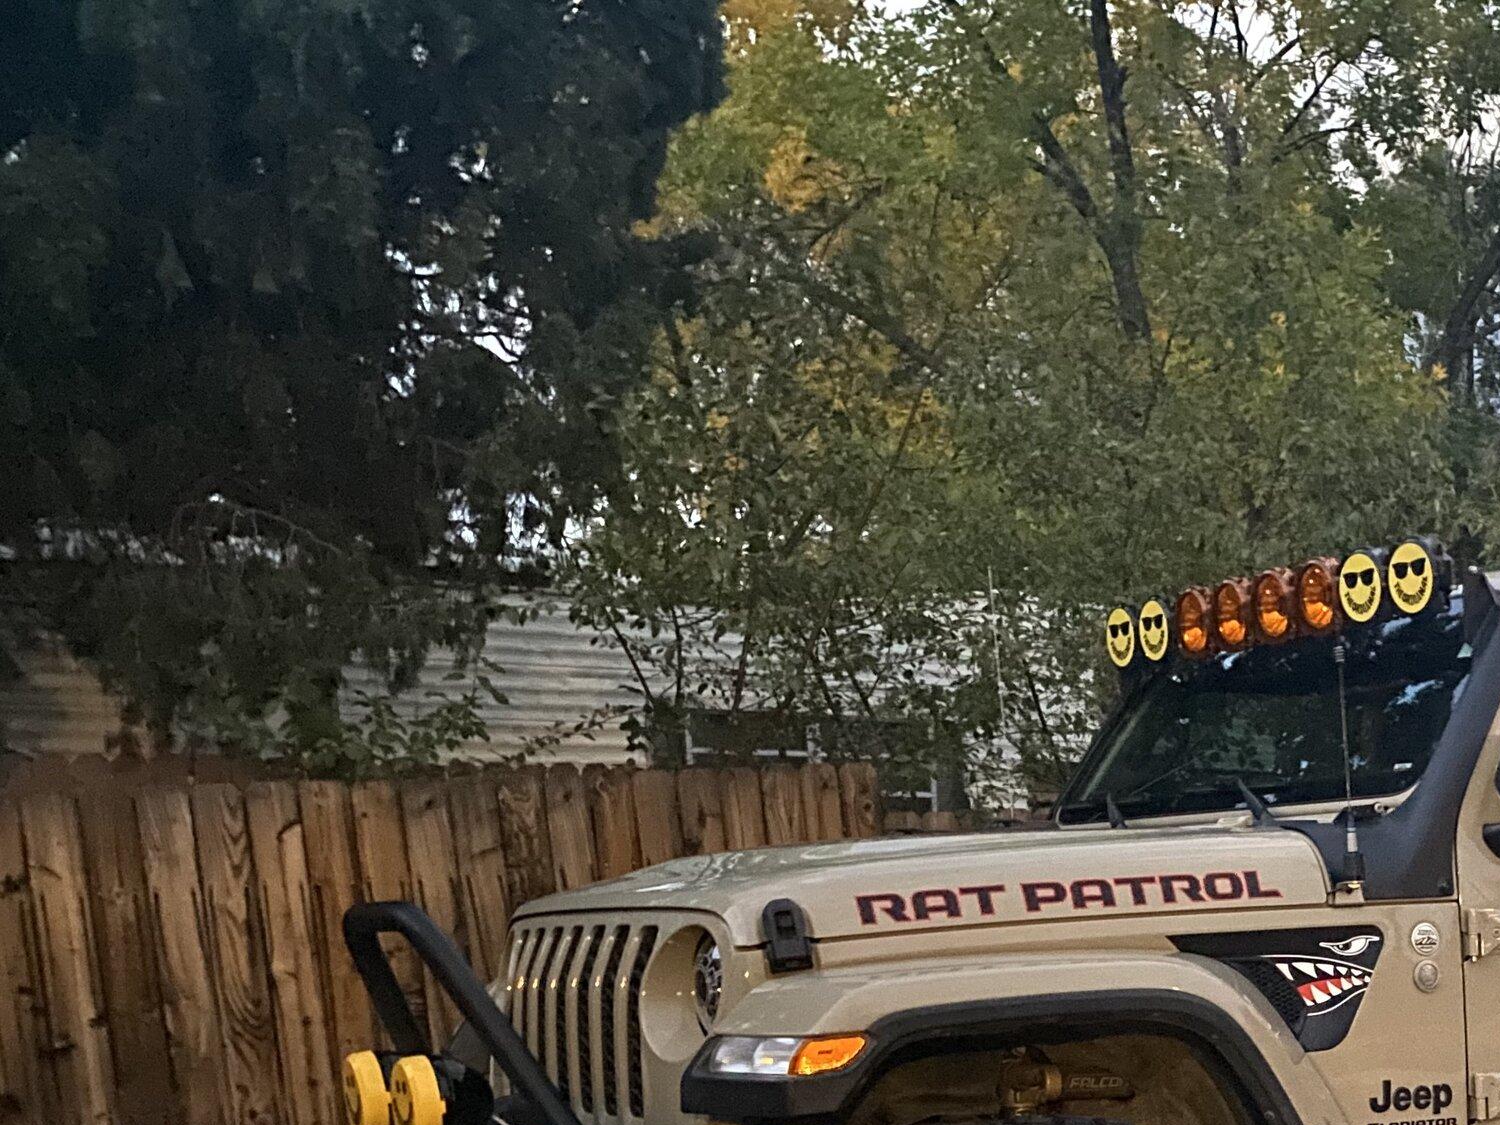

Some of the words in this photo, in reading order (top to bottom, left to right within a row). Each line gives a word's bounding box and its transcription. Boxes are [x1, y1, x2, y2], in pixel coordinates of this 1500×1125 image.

[854, 884, 1005, 926] RAT
[1019, 870, 1283, 912] PATROL
[1369, 1079, 1452, 1115] Jeep
